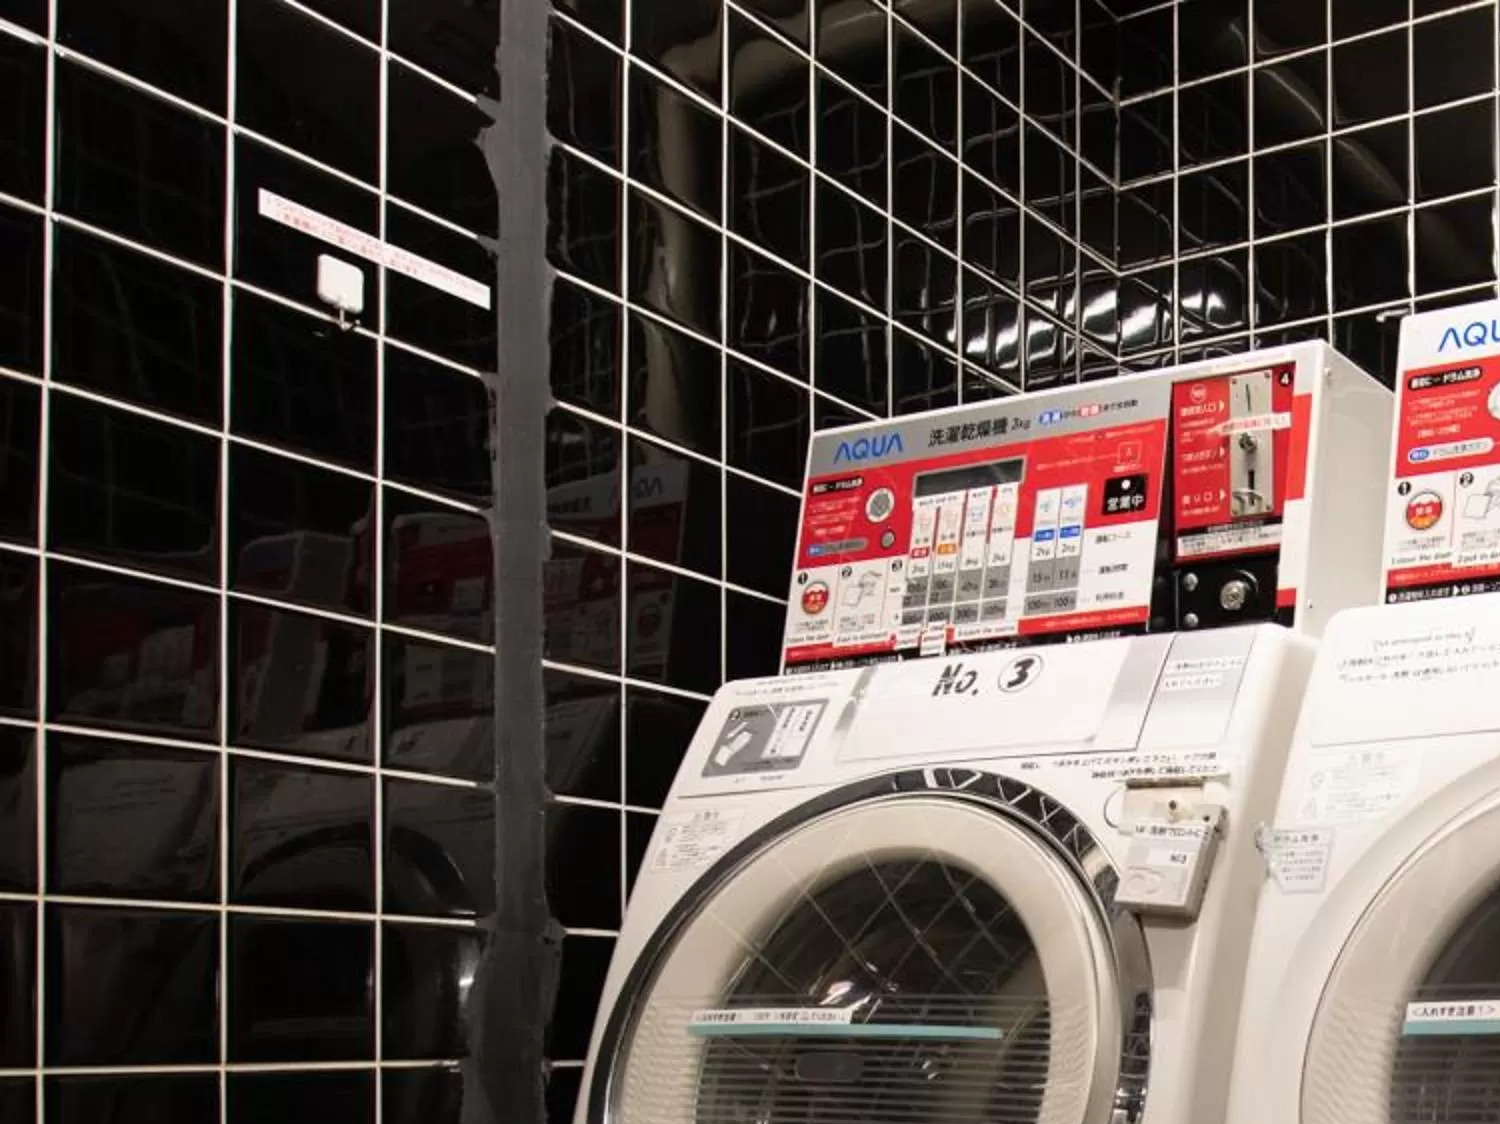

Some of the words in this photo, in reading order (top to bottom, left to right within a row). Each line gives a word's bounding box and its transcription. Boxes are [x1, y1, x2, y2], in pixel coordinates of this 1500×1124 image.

[833, 431, 904, 464] AQUA
[928, 417, 1009, 448] 洗濯乾燥機
[931, 661, 979, 697] No.
